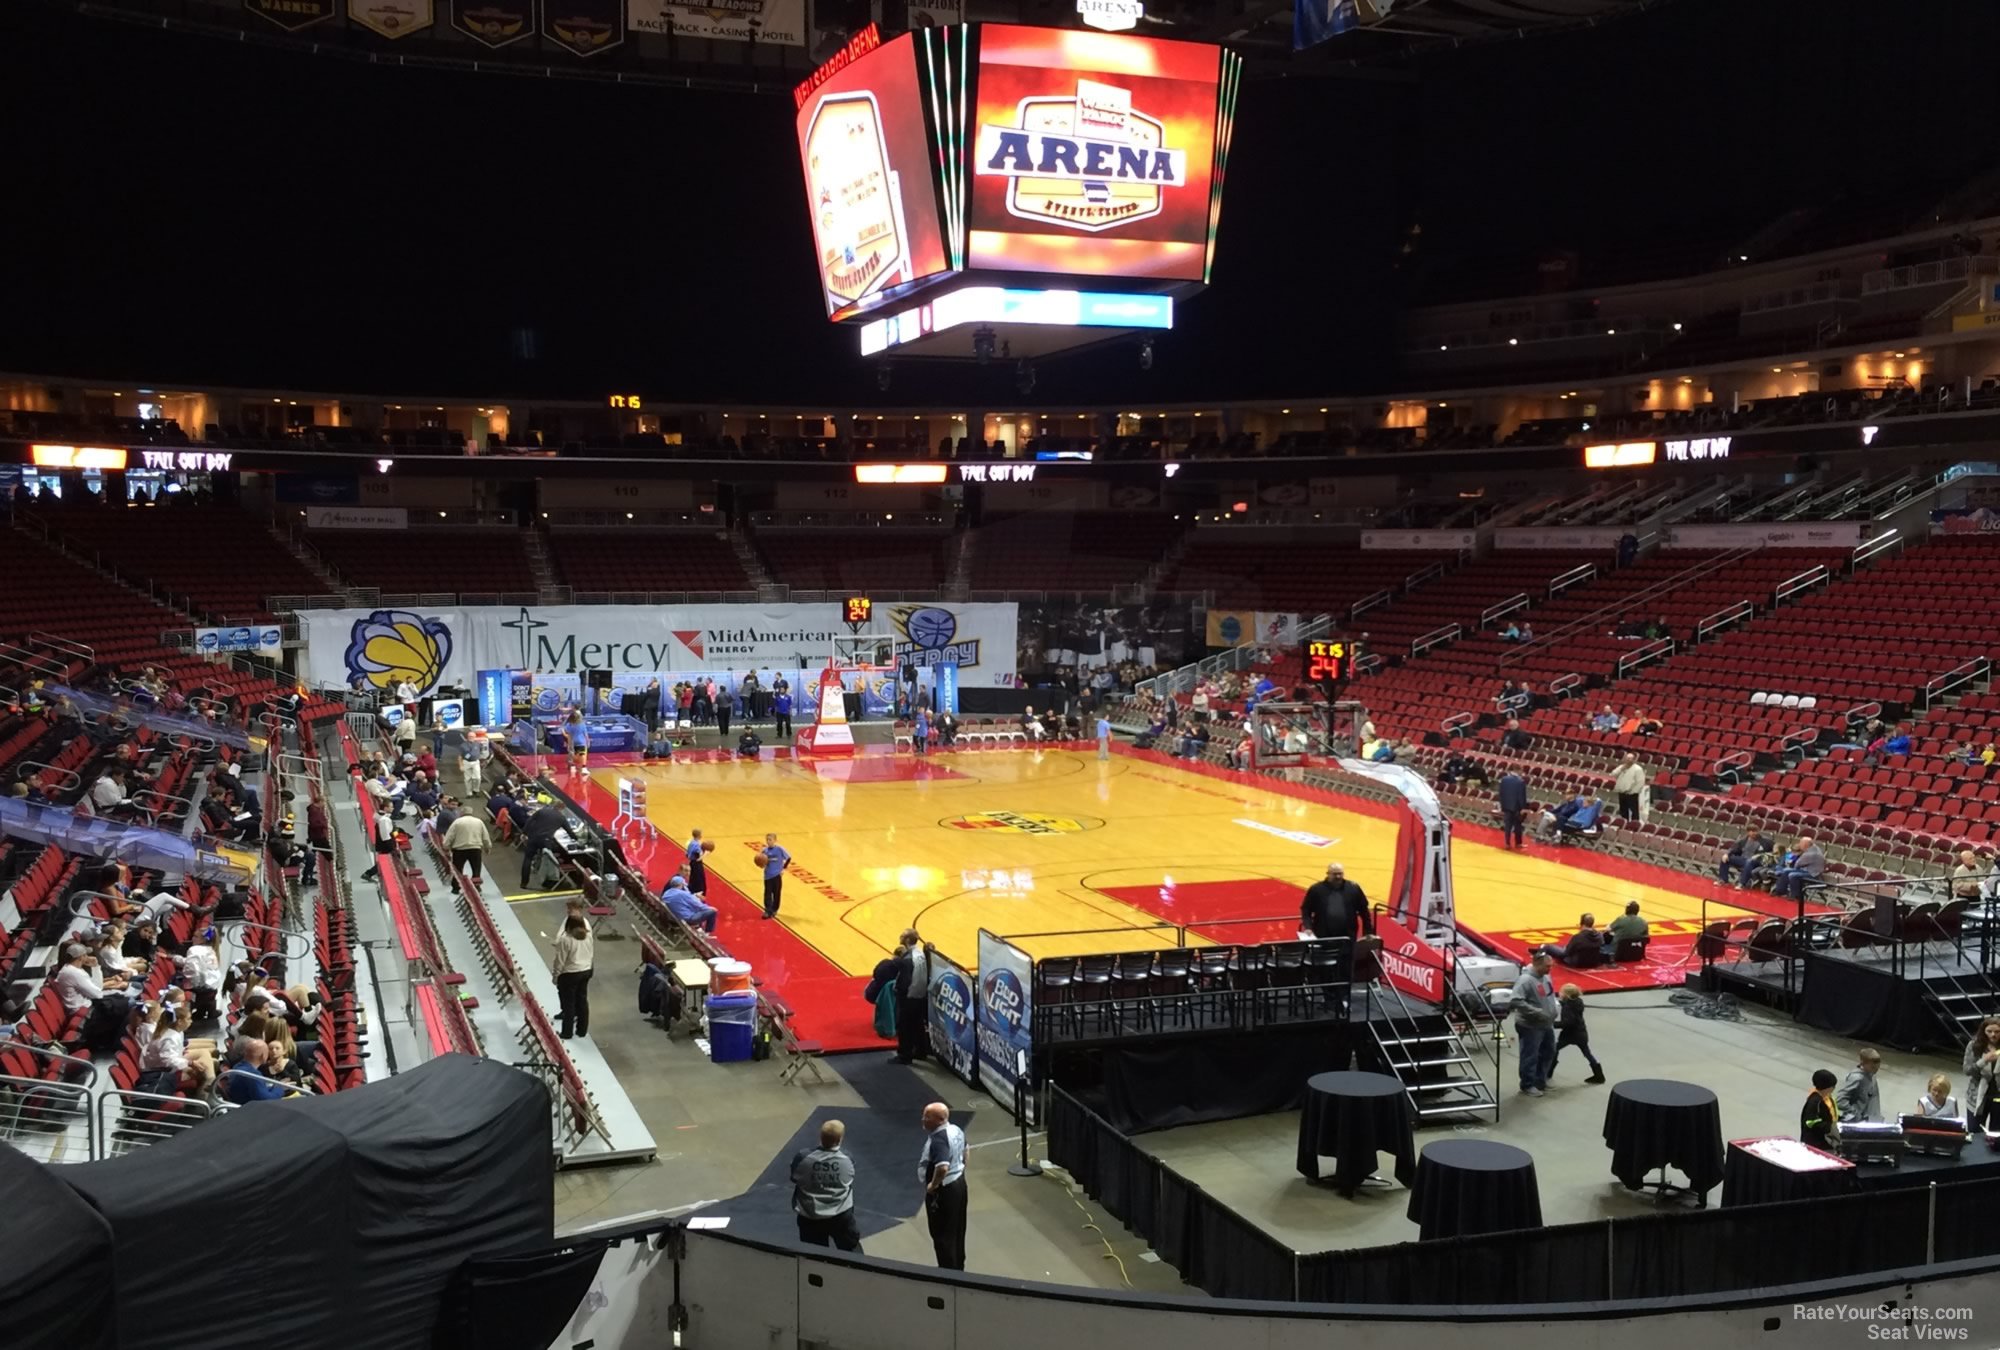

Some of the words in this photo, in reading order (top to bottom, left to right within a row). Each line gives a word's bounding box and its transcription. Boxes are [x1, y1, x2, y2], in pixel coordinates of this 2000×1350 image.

[711, 0, 762, 12] MEADOWS
[637, 20, 700, 34] RACERACK
[761, 31, 795, 42] HOTEL
[848, 21, 881, 63] ARENA
[988, 131, 1175, 182] ARENA
[1689, 438, 1712, 460] OUT
[1709, 437, 1733, 459] BOY
[142, 451, 176, 470] FALL
[177, 451, 205, 471] OUT
[205, 452, 233, 472] BOY
[988, 464, 1013, 482] OUT
[1012, 465, 1037, 482] BOY
[850, 607, 867, 621] 24
[708, 628, 839, 644] MidAmerican
[537, 635, 669, 673] Mercy
[709, 645, 755, 654] ENERGY
[1310, 656, 1338, 679] 24
[1381, 950, 1435, 994] PALDING
[940, 982, 963, 1008] BUD
[995, 979, 1020, 1007] BUD
[936, 994, 968, 1025] LIGHT
[988, 992, 1022, 1025] LIGHT
